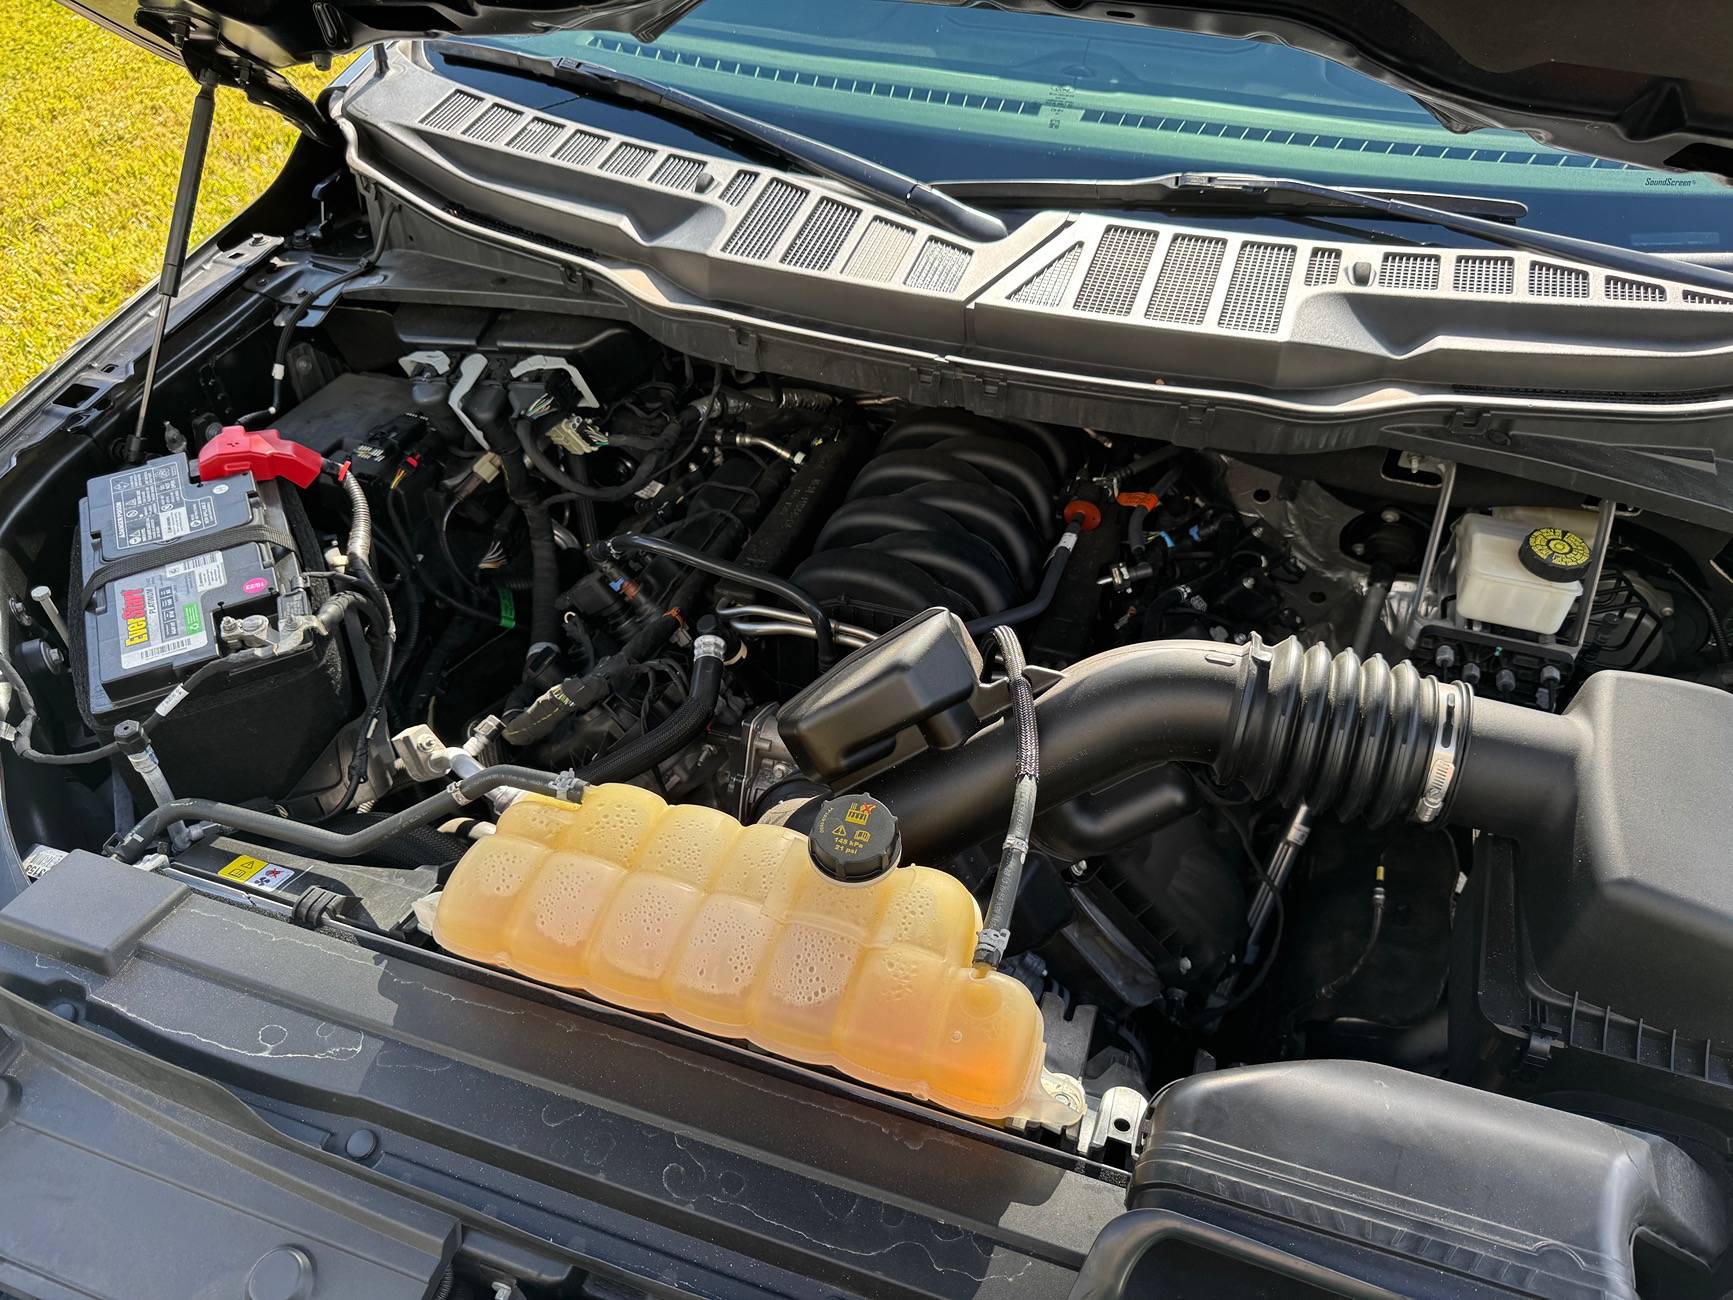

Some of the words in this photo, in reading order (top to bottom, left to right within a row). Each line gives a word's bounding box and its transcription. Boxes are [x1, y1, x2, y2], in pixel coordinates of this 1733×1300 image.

[1645, 178, 1691, 186] SoundScreen
[145, 587, 157, 614] PLATINUM
[121, 589, 149, 647] EverStart
